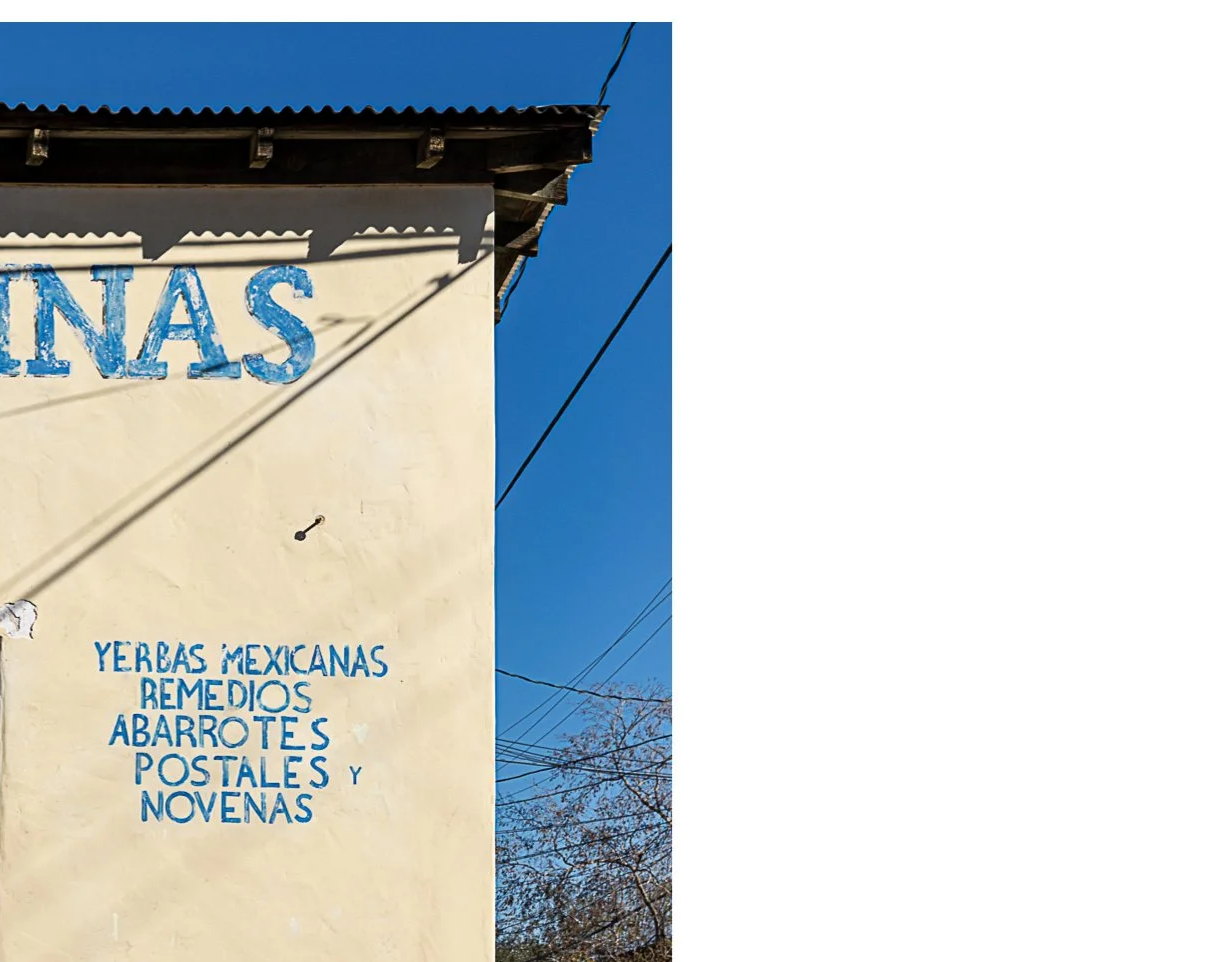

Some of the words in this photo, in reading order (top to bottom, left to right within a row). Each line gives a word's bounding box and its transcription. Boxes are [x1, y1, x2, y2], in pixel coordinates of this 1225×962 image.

[94, 641, 207, 674] YERBAS
[221, 643, 388, 678] MEXICANAS
[140, 677, 313, 714] REMEDIOS
[108, 713, 330, 751] ABARROTES
[134, 752, 330, 789] POSTALES
[348, 766, 363, 785] Y
[141, 790, 313, 824] NOVENAS
